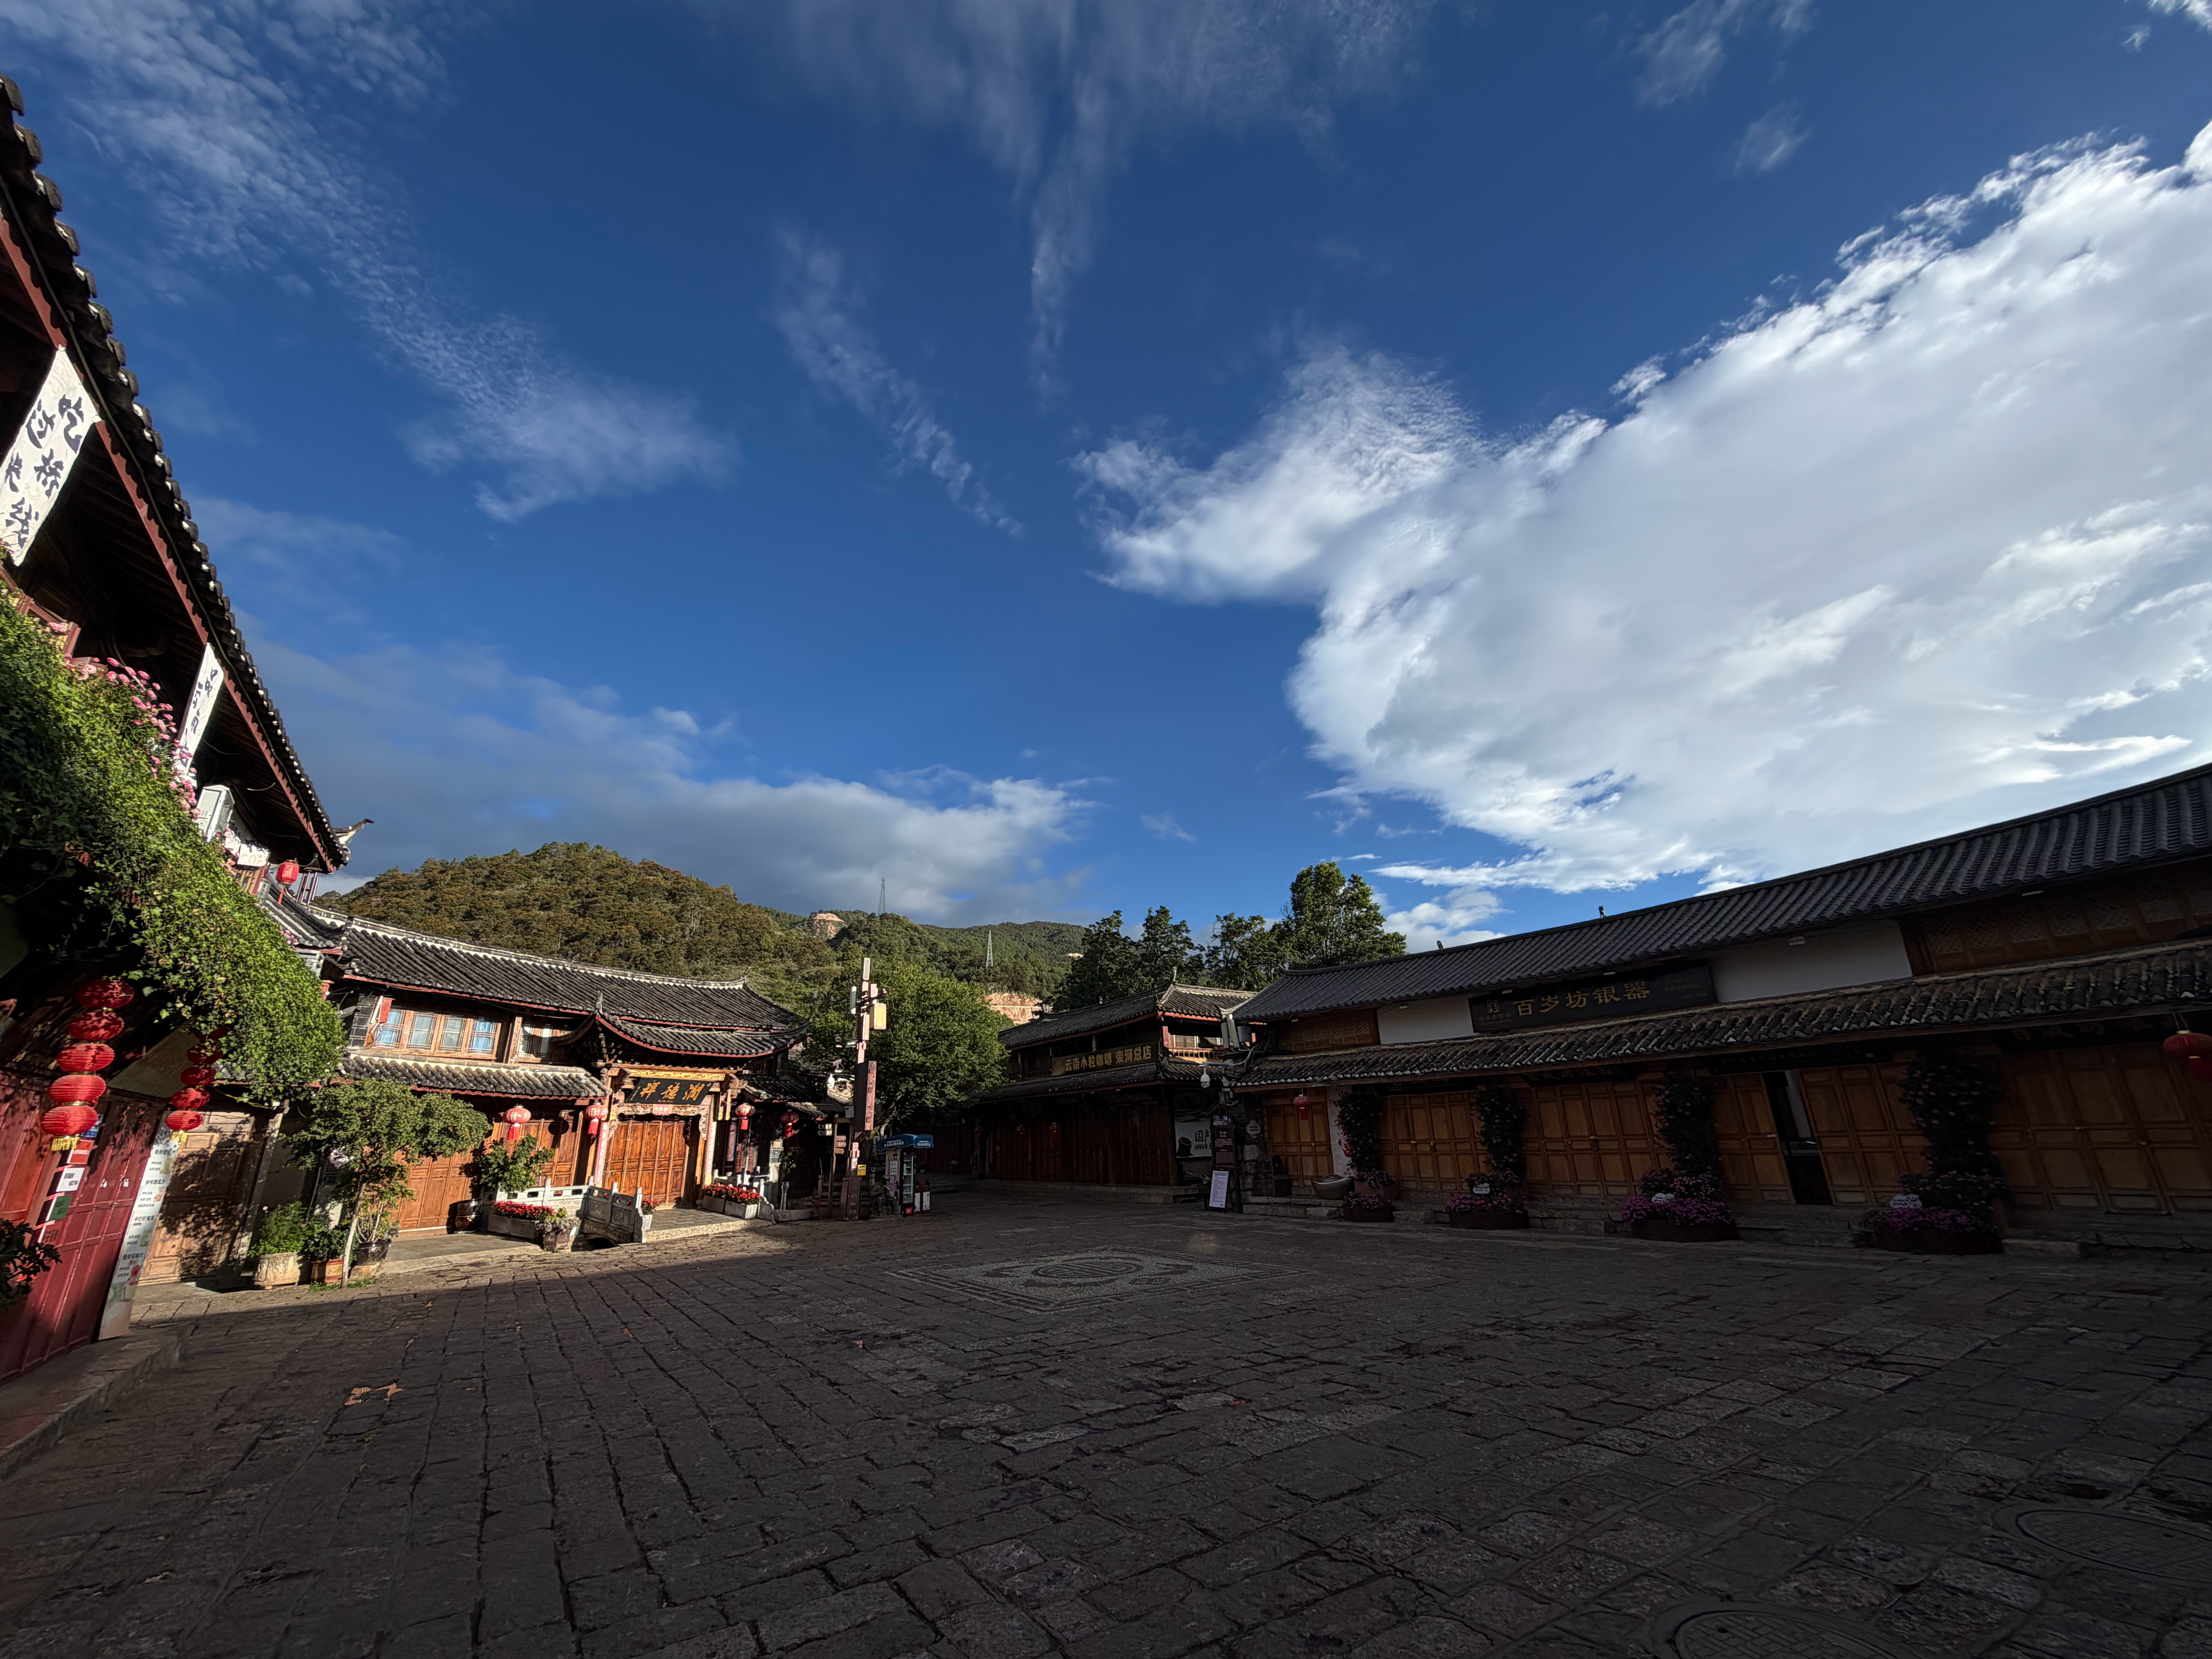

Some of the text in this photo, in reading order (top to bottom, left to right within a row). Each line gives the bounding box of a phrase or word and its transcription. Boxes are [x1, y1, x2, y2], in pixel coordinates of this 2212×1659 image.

[1512, 981, 1651, 1017] 百岁坊银器
[1065, 1045, 1152, 1072] 云南小粒咖啡 束河总店
